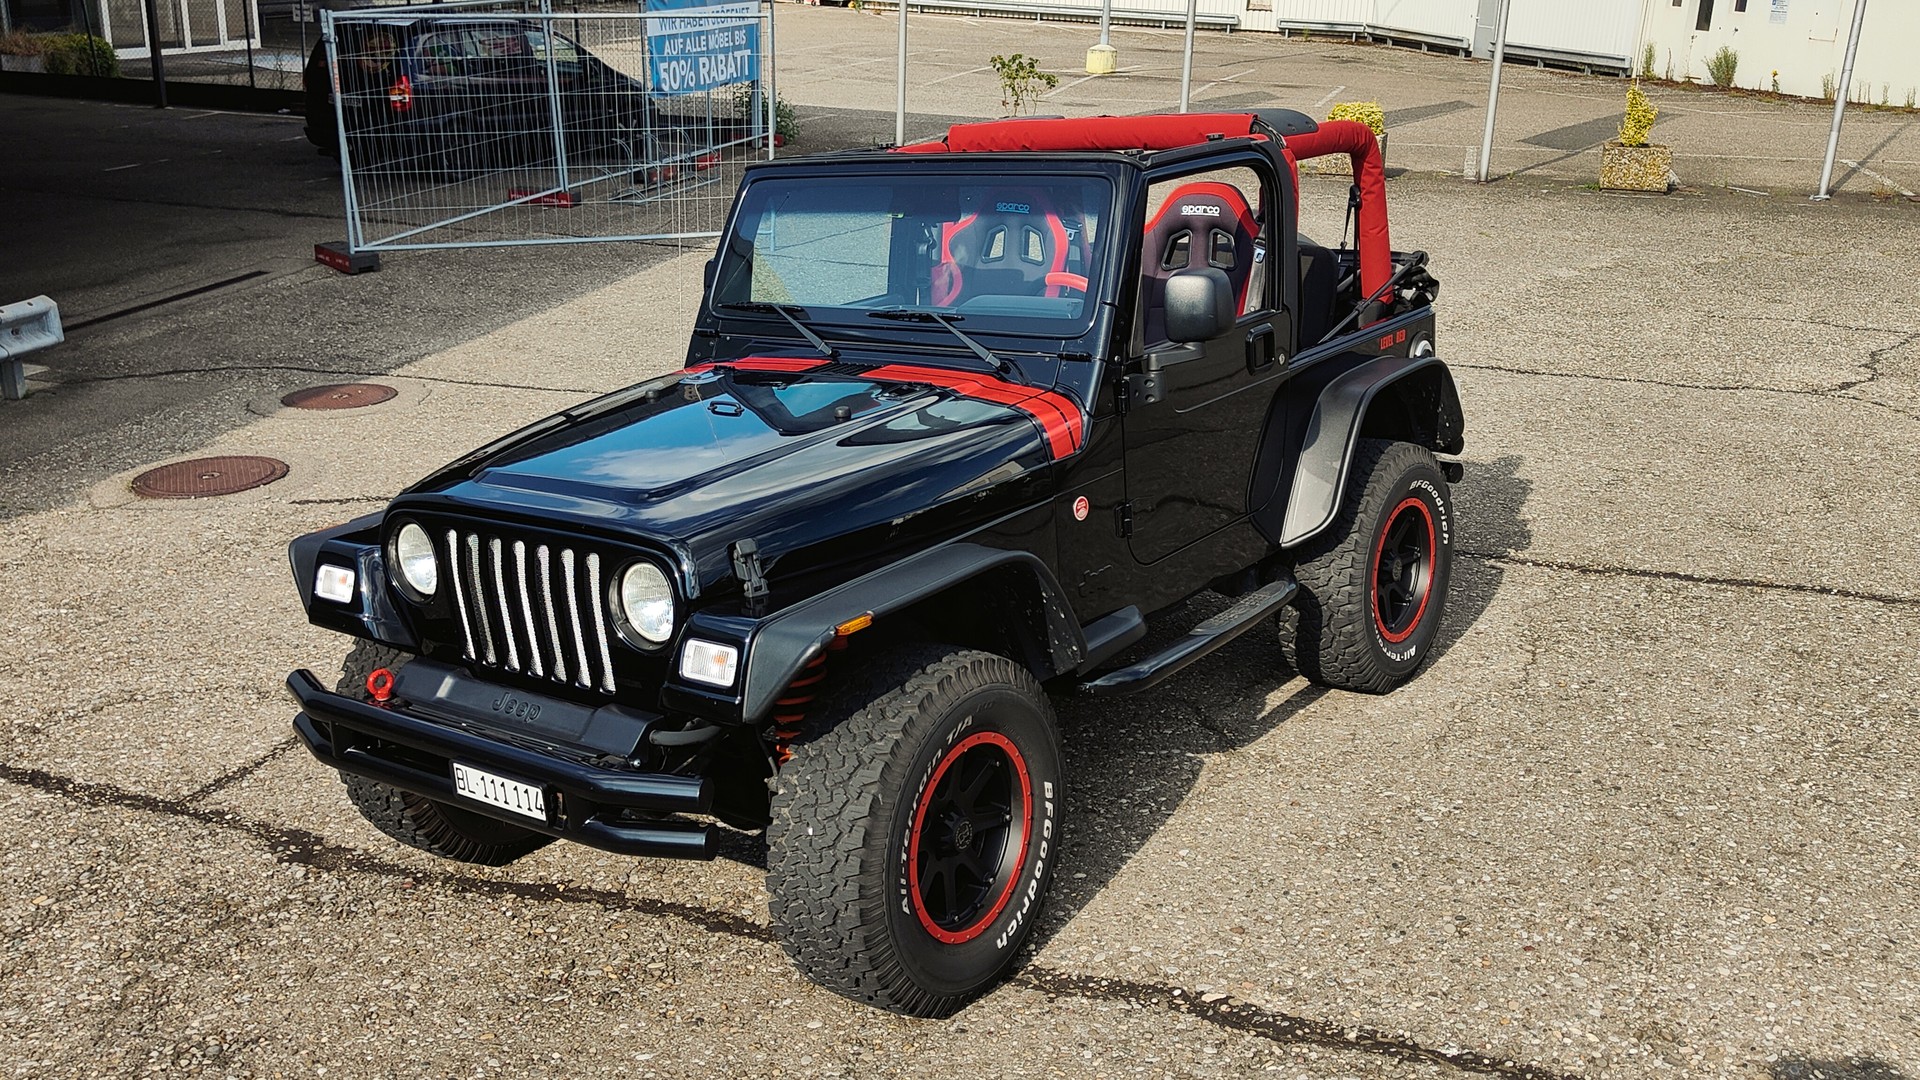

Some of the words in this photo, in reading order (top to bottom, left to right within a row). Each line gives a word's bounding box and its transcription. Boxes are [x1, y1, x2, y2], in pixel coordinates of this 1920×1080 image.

[658, 17, 677, 31] WIR
[664, 39, 683, 56] AUF
[685, 35, 707, 53] ALLE
[708, 30, 733, 50] MÖBEL
[735, 29, 747, 45] BIS
[659, 57, 695, 92] 50%
[699, 49, 750, 86] RABATT
[996, 202, 1030, 214] sparco
[1181, 205, 1220, 216] sparco
[1409, 479, 1449, 545] BFGoodrich
[492, 692, 541, 723] Jeep
[900, 748, 942, 915] All-Terrain
[946, 715, 973, 745] T/A
[996, 781, 1054, 949] BFGoodrich
